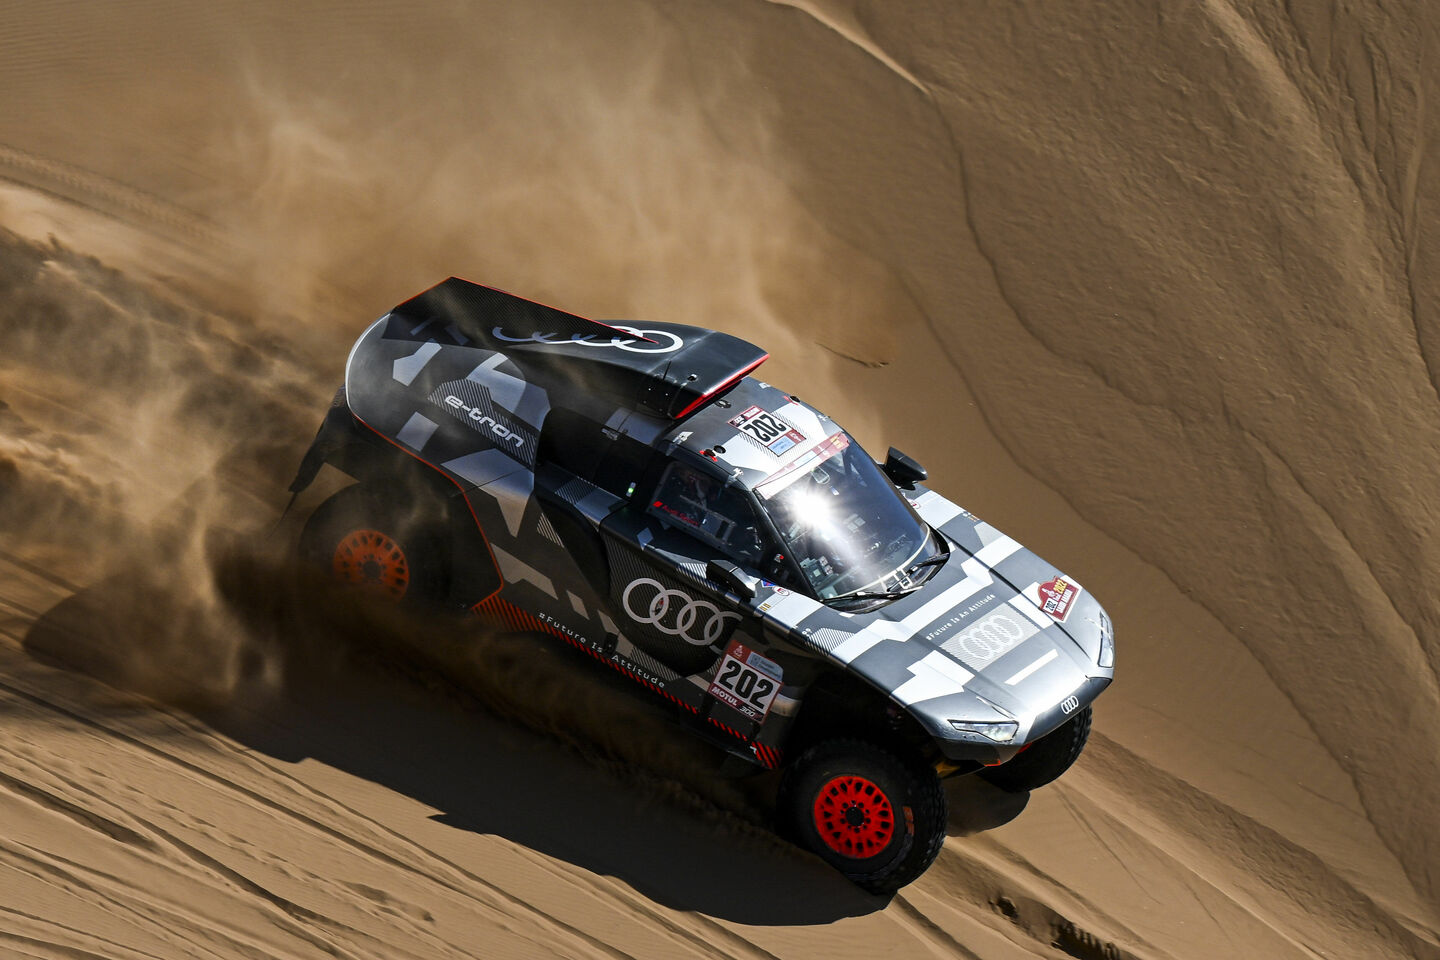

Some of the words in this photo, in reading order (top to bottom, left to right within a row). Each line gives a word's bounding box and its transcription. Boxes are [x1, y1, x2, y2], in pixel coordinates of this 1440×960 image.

[445, 395, 524, 448] e-tron
[743, 413, 787, 442] 202
[959, 611, 970, 619] An
[968, 594, 996, 613] Attitude
[1045, 600, 1057, 611] 202
[538, 612, 587, 644] #Future
[591, 641, 603, 653] Is
[611, 654, 666, 689] Attitude
[718, 660, 774, 710] 202
[711, 686, 739, 707] MOTUL
[739, 705, 756, 717] 300
